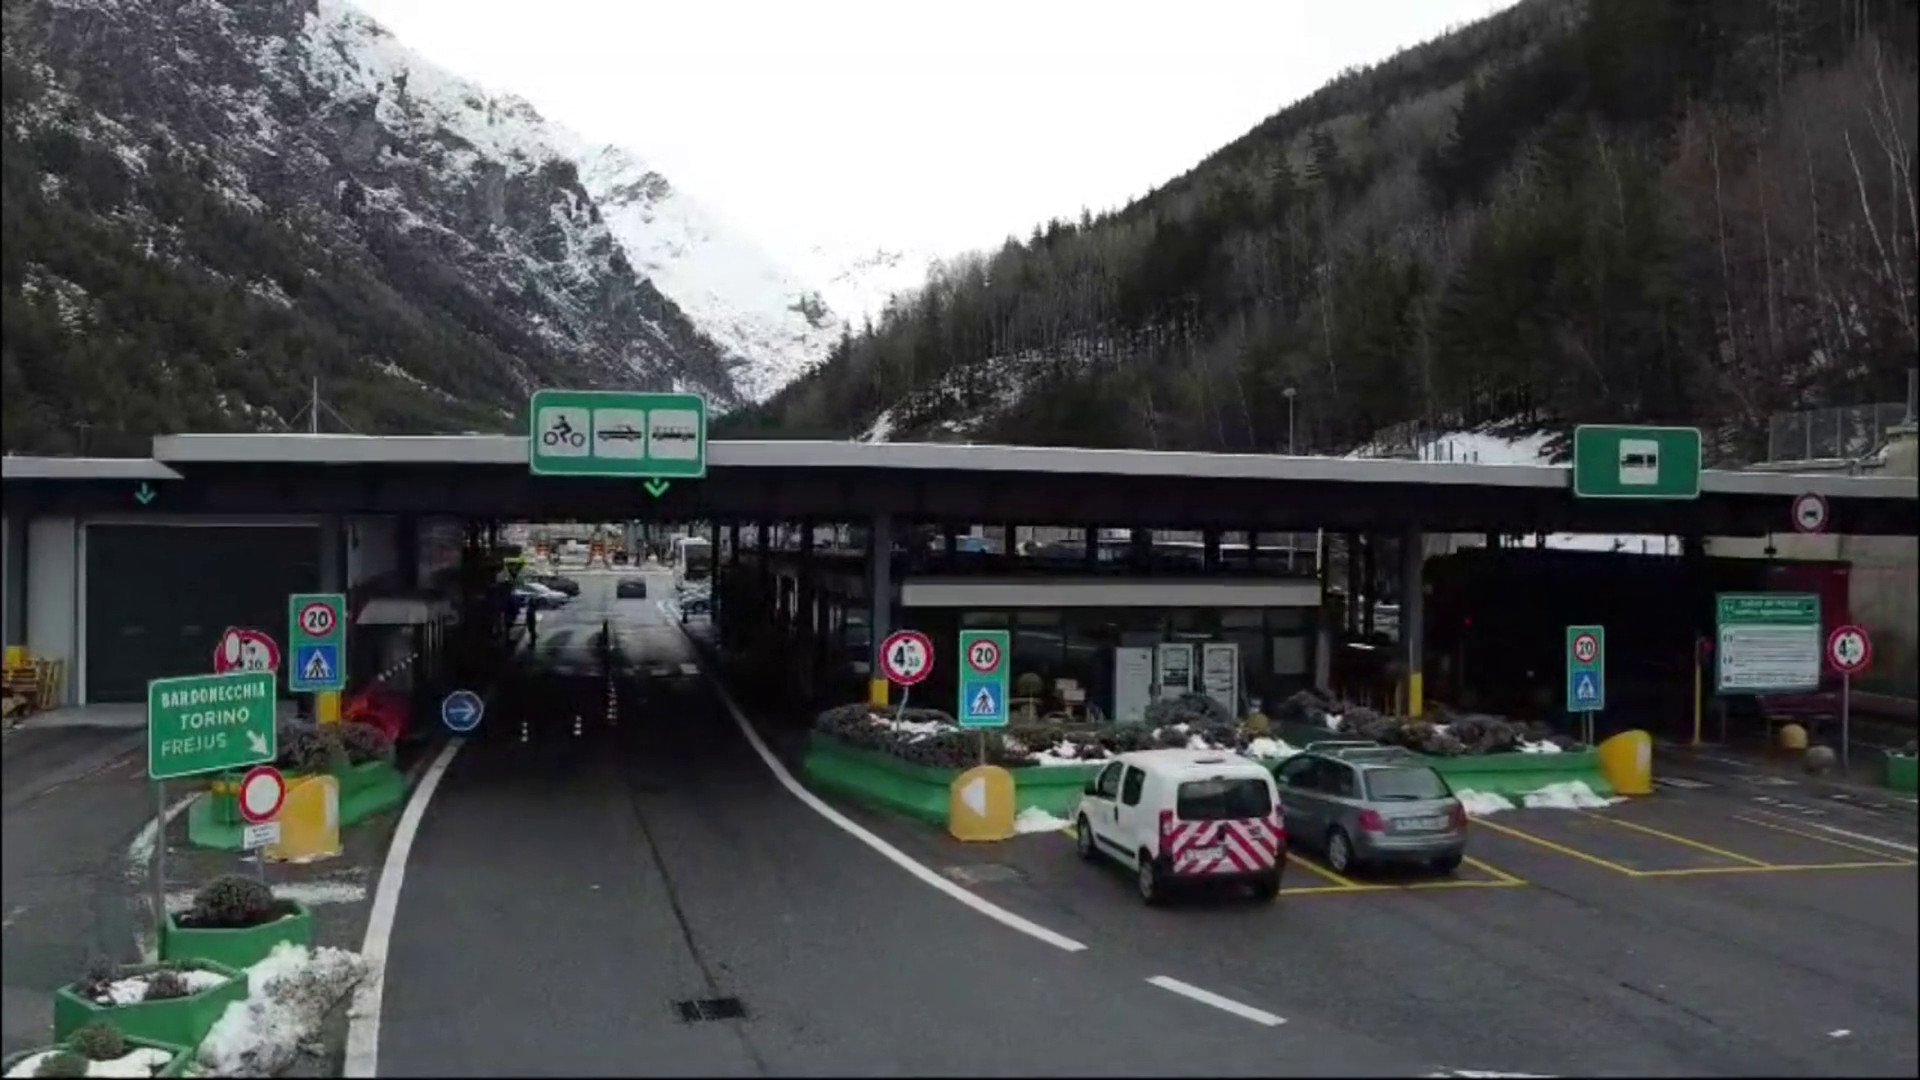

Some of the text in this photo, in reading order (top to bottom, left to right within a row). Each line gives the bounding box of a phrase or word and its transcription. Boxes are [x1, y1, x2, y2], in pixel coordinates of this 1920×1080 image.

[307, 611, 329, 628] 20
[893, 645, 905, 668] 4
[975, 647, 995, 664] 20
[1578, 640, 1594, 656] 20
[161, 681, 265, 709] BARDONECCHIA
[180, 706, 250, 731] TORINO
[161, 731, 227, 758] FREJUS
